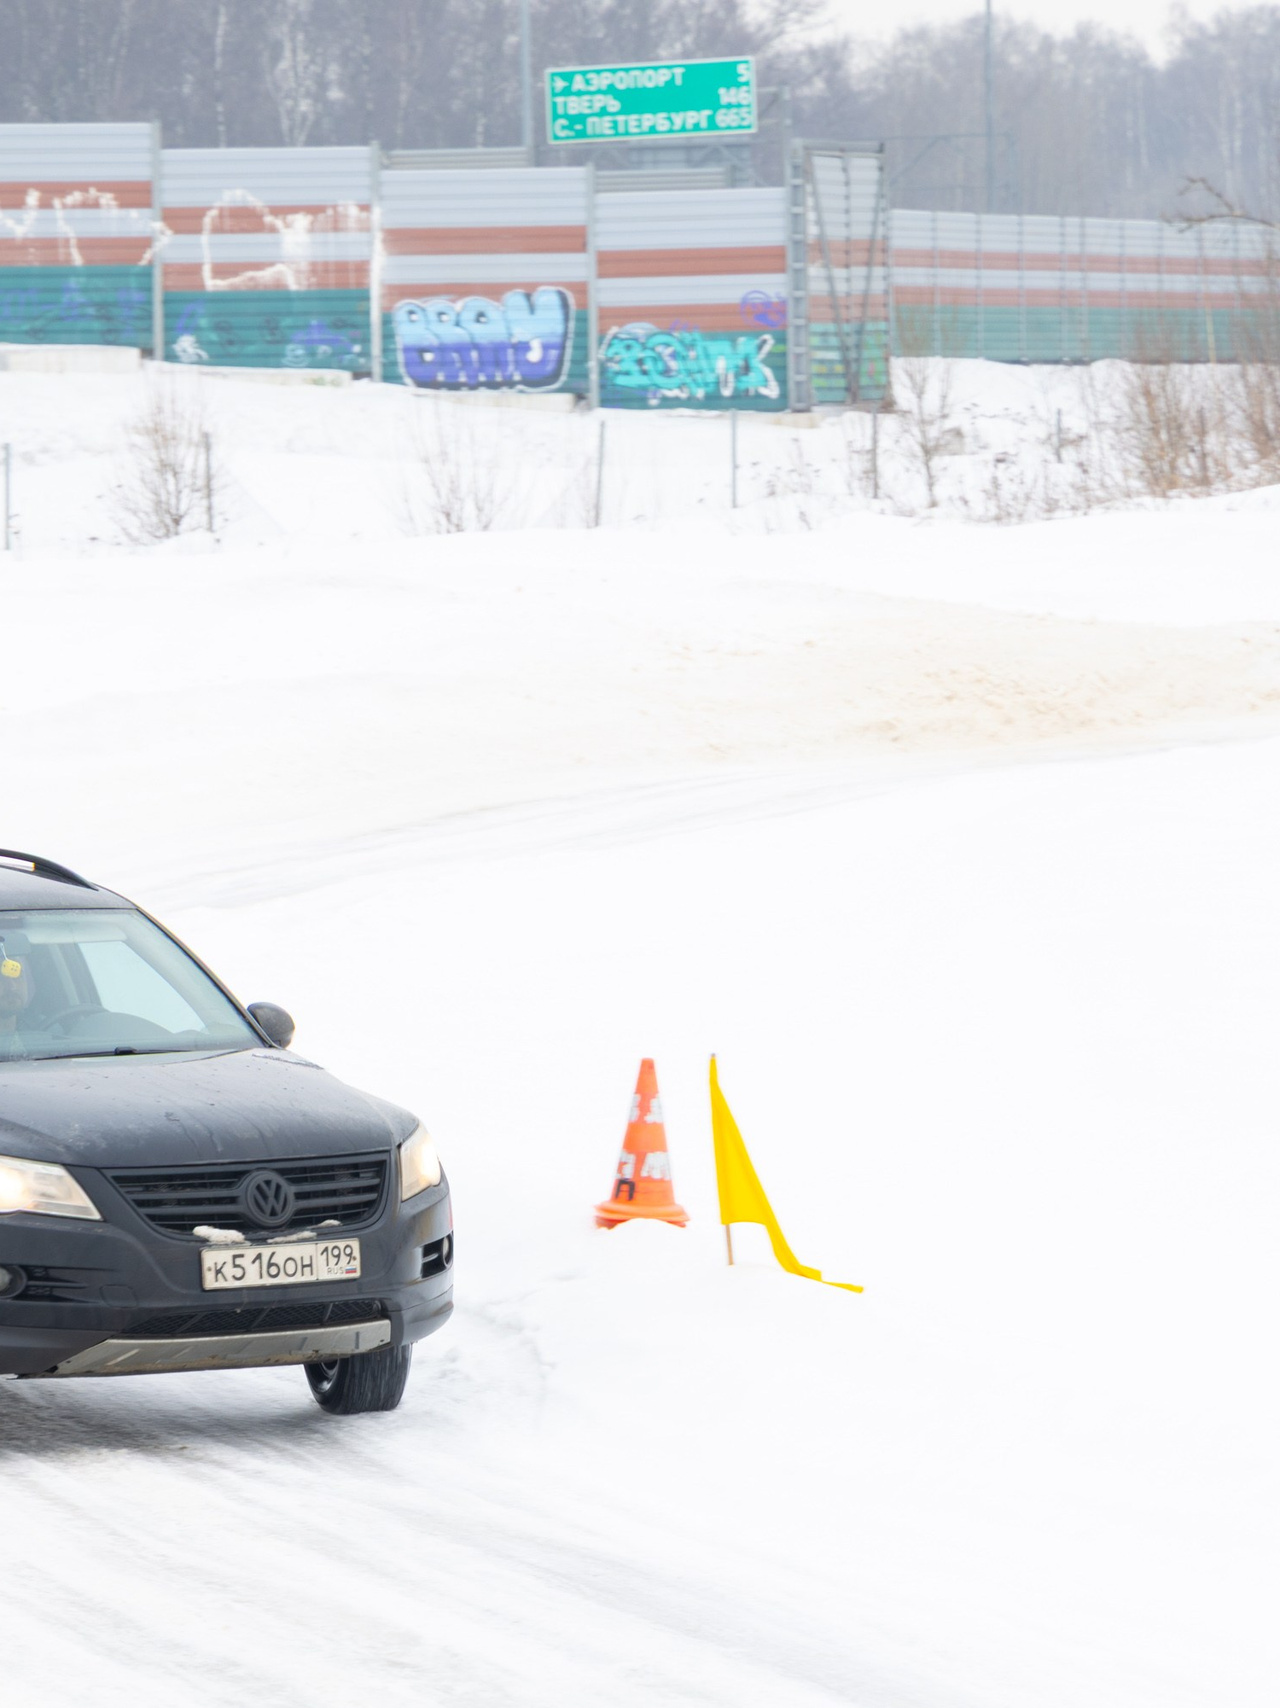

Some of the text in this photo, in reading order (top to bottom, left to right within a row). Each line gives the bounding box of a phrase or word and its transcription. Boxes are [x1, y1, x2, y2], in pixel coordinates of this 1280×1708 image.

[571, 63, 750, 92] АЭРОПОРТ 5
[552, 86, 750, 116] ТВЕРЬ 146
[714, 107, 751, 128] 665
[320, 1244, 354, 1267] 199
[326, 1266, 345, 1276] RUS
